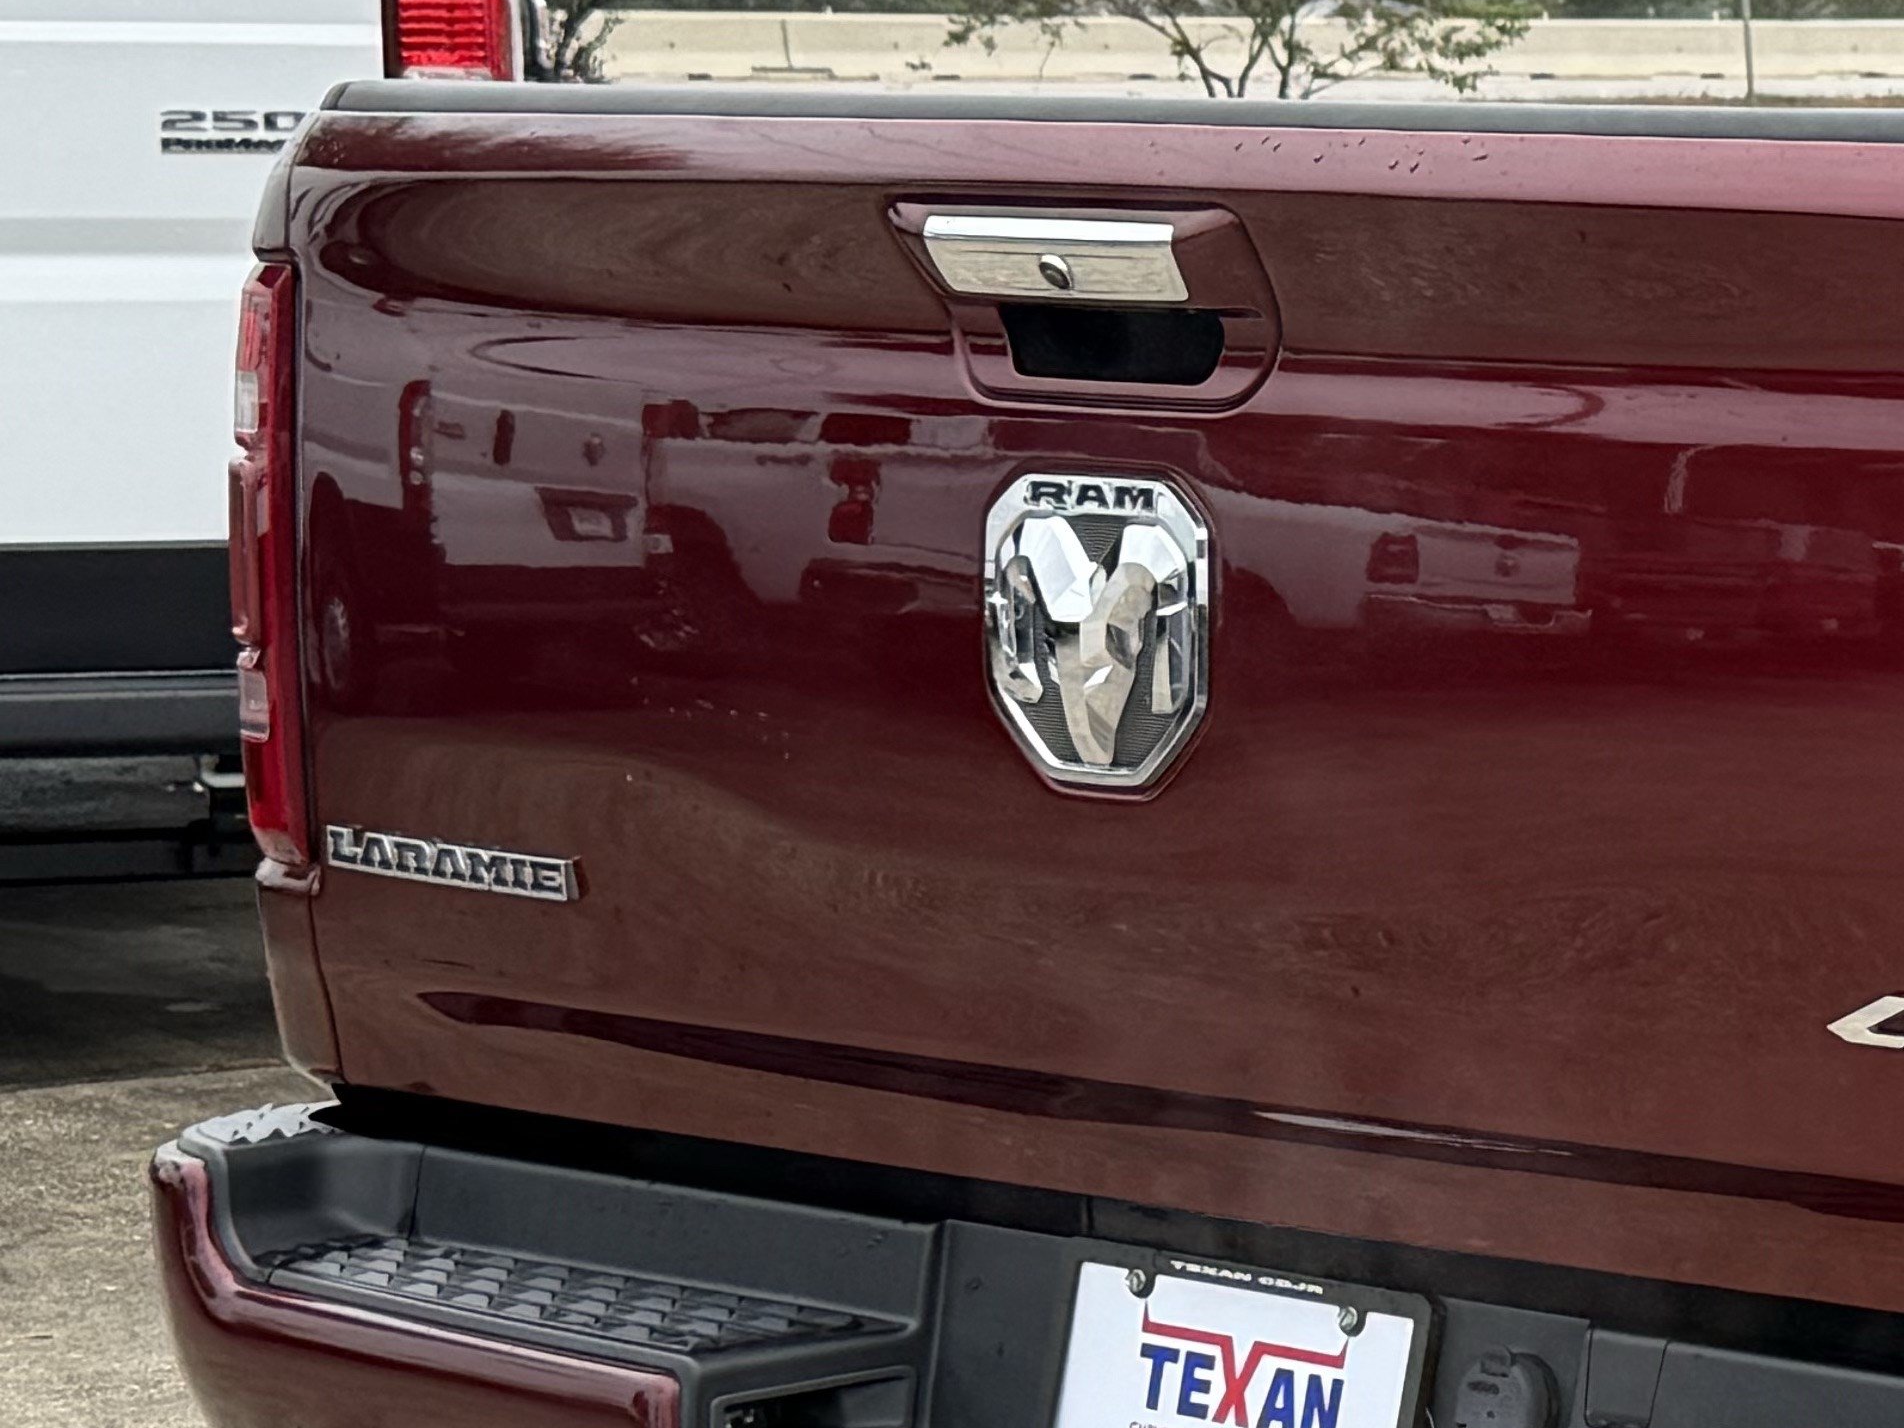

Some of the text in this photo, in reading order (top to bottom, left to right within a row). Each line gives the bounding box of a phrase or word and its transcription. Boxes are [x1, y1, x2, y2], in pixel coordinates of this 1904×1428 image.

[1026, 480, 1155, 510] RAM
[328, 826, 567, 900] LARAMIE
[1170, 1259, 1324, 1295] TEXAN CDJR
